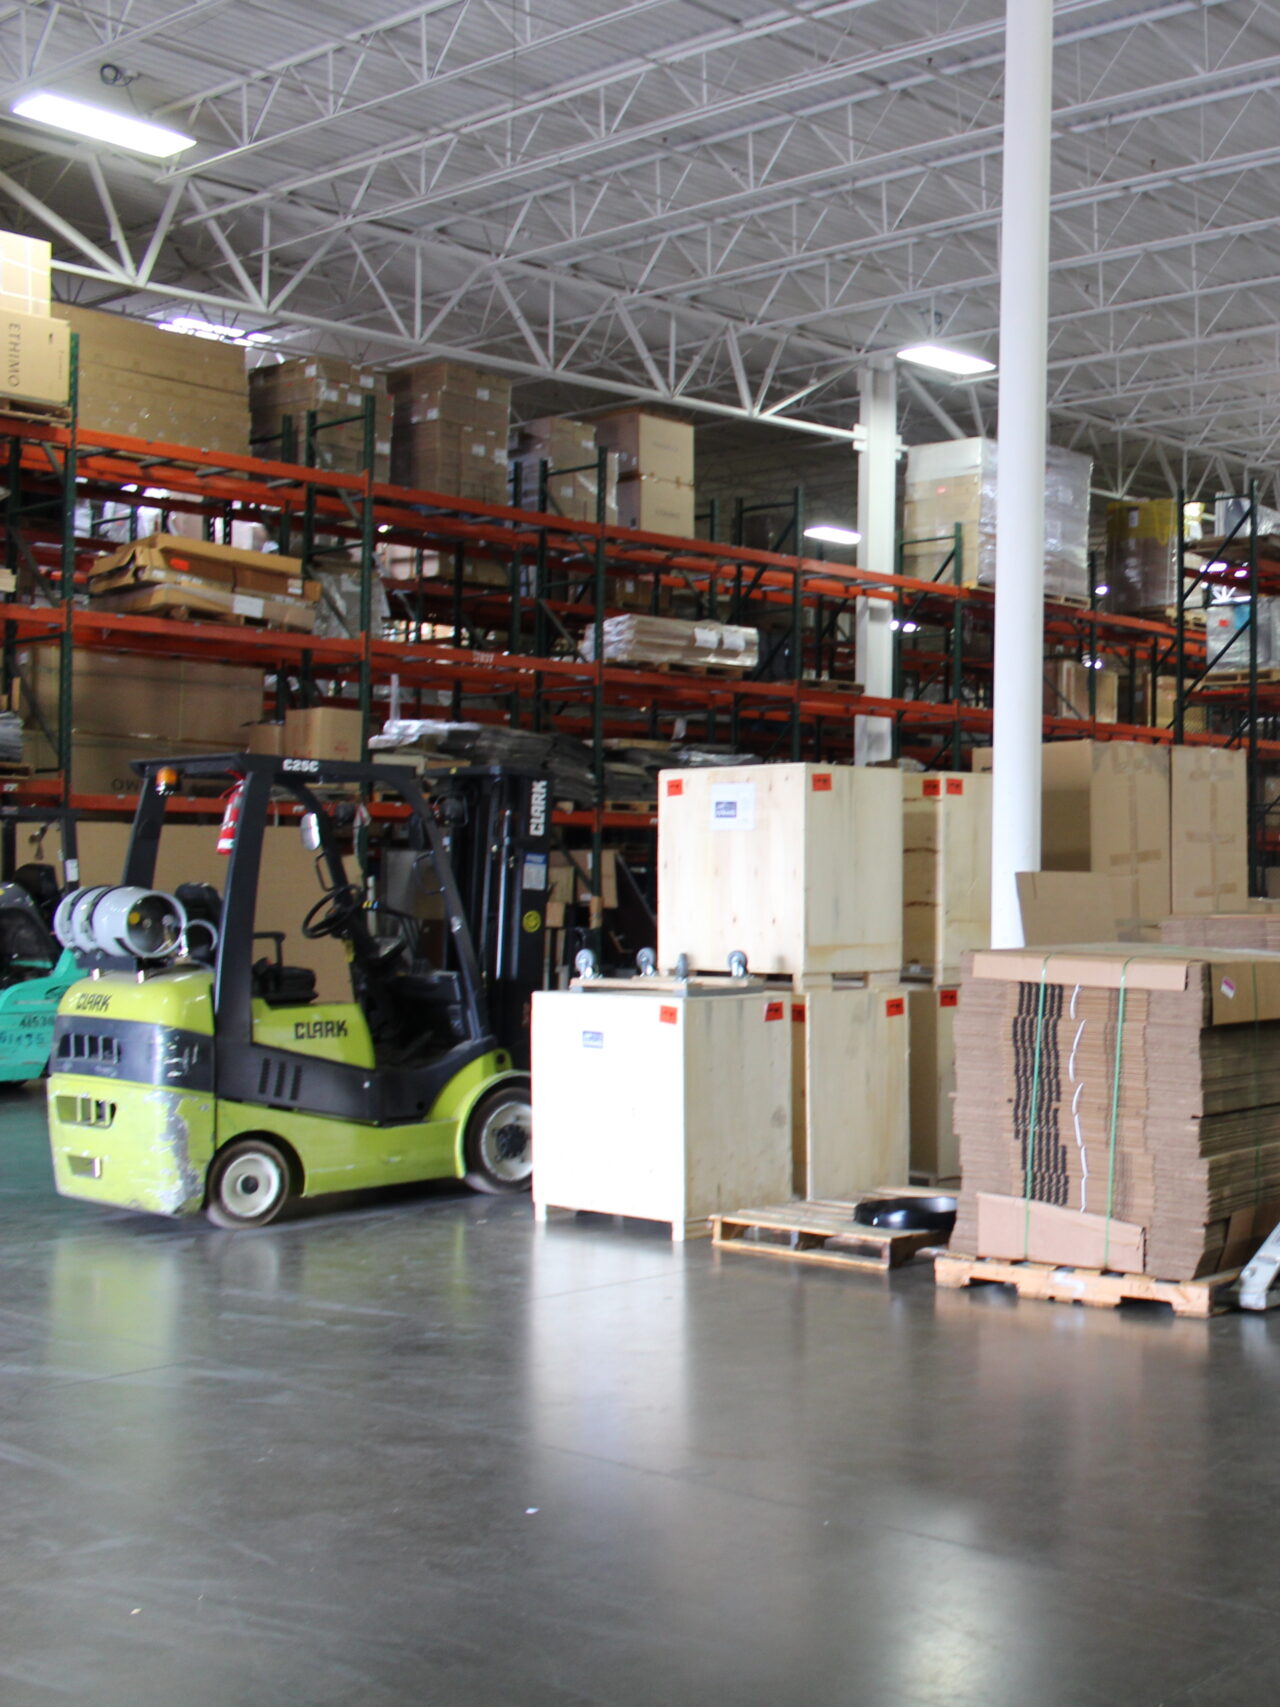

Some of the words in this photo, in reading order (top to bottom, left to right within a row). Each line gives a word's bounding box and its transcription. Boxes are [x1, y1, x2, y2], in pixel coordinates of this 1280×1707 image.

[282, 758, 320, 772] C25C
[529, 780, 548, 837] CLARK
[75, 993, 112, 1012] CLARK
[294, 1020, 349, 1040] CLARK
